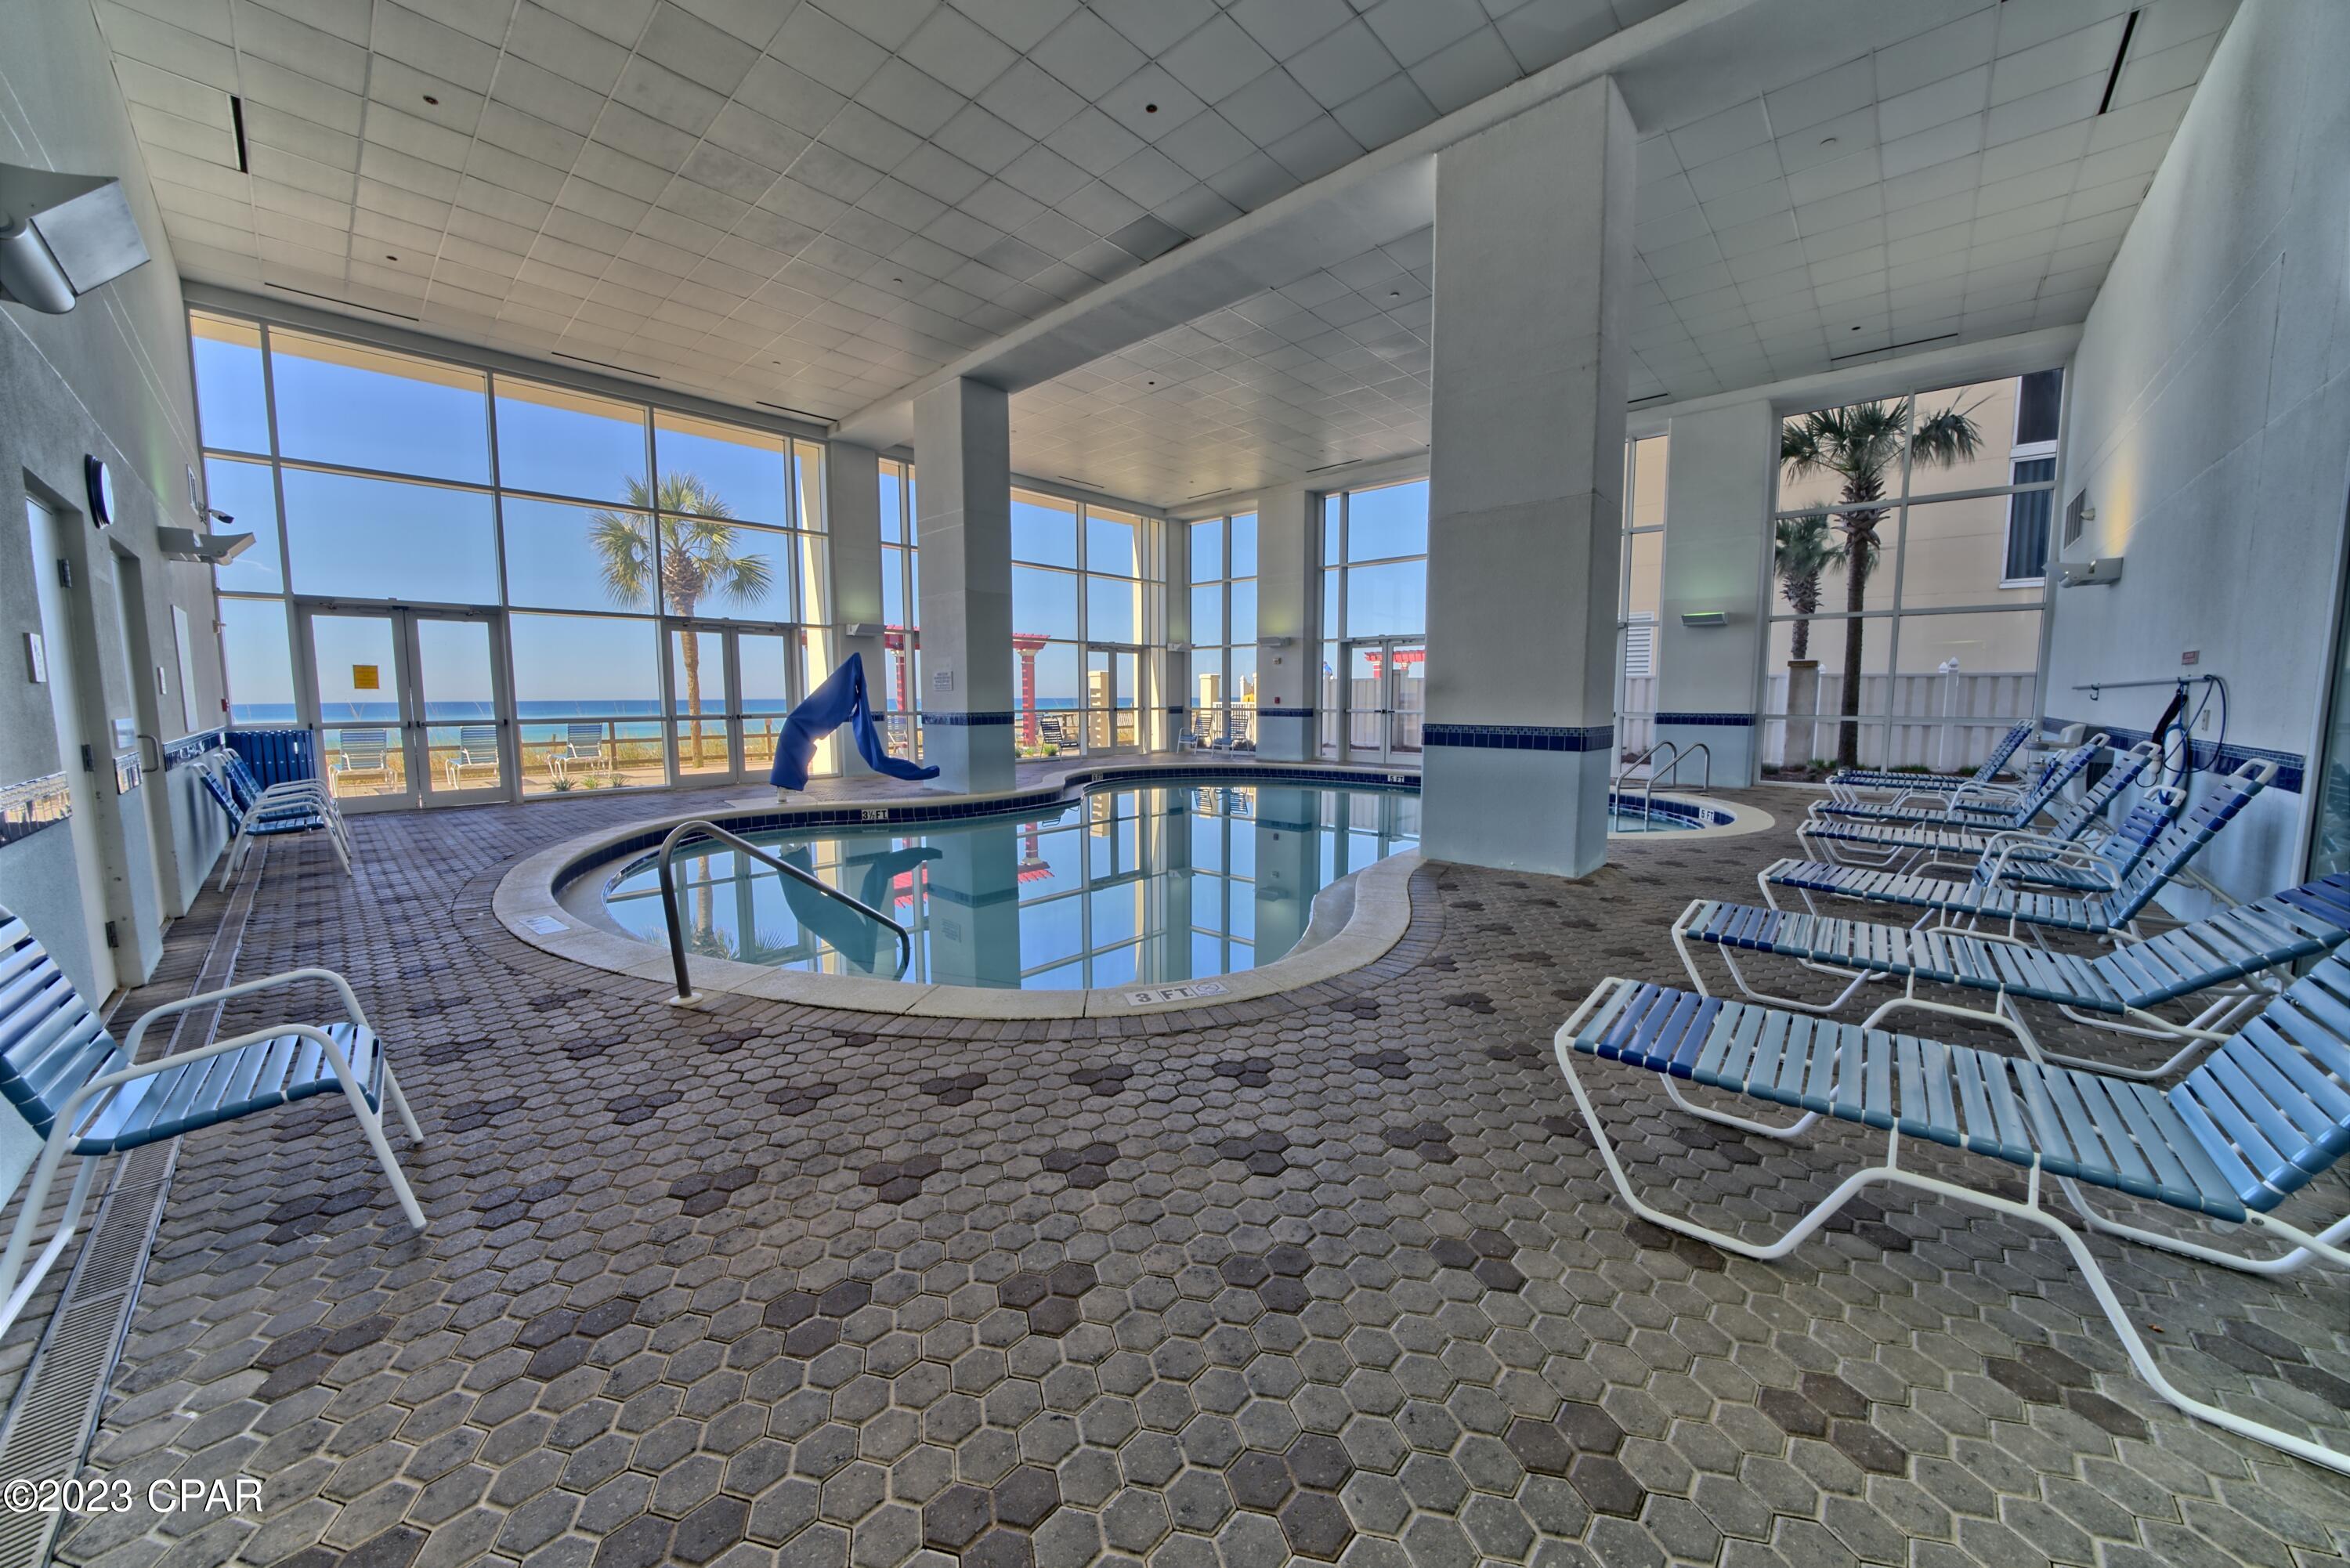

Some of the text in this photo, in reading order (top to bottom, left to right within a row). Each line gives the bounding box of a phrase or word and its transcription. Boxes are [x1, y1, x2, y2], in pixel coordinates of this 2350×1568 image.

[1701, 809, 1714, 821] 5 FT
[1134, 992, 1152, 1003] 3
